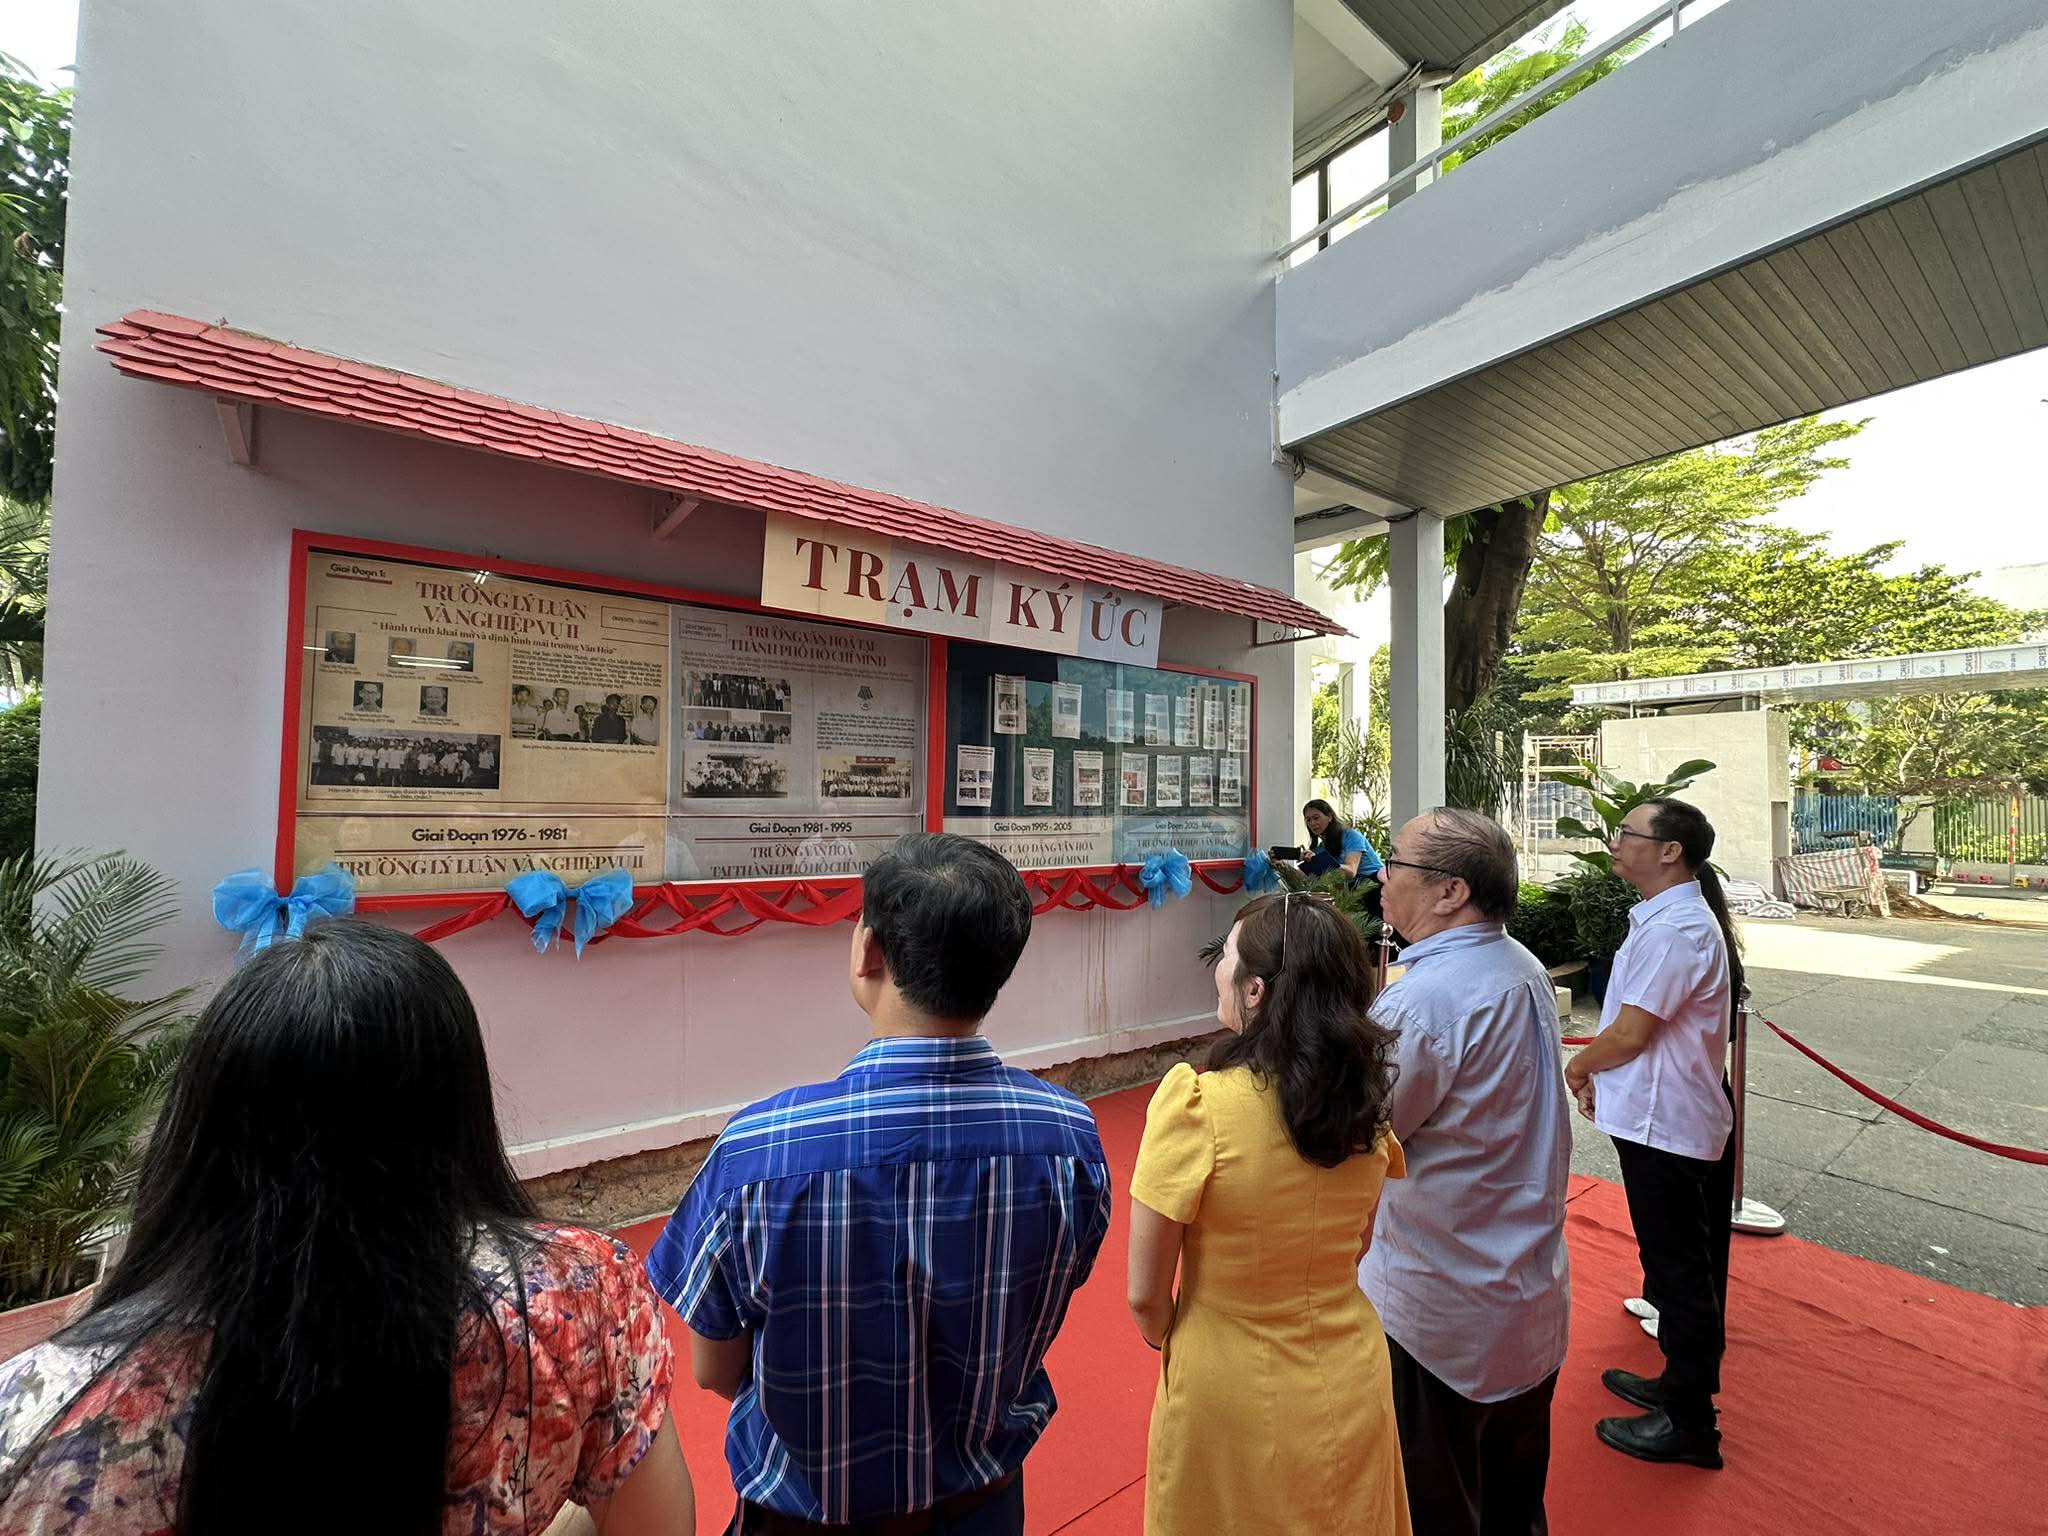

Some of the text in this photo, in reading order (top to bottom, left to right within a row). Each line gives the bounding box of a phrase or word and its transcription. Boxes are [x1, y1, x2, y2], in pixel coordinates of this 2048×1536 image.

[330, 563, 351, 573] Giai
[352, 567, 378, 579] Đoạn
[795, 537, 1149, 648] TRẠM KÝ ỨC
[416, 581, 508, 609] TRƯỜNG
[512, 592, 536, 613] LÝ
[538, 599, 588, 621] LUẬN
[423, 602, 579, 640] VÀ NGHIỆP VỤ II
[380, 622, 408, 632] Hành
[409, 624, 435, 635] trình
[436, 627, 458, 637] khai
[854, 653, 887, 668] MINH
[749, 822, 771, 833] Giai
[773, 822, 801, 836] Đoạn
[803, 823, 823, 833] 1981
[830, 822, 852, 832] 1995
[994, 822, 1010, 832] Giai
[1011, 822, 1031, 834] Đoạn
[1032, 823, 1049, 832] 1995
[1053, 822, 1072, 831] 2005
[412, 828, 444, 841] Giai
[447, 828, 489, 845] Đoạn
[491, 828, 527, 841] 1976
[538, 828, 568, 841] 1981
[336, 857, 427, 876] TRƯỜNG
[430, 856, 453, 875] LÝ
[456, 855, 506, 876] LUẬN
[512, 854, 536, 872] VÀ
[539, 853, 606, 873] NGHIỆP
[633, 855, 643, 869] II
